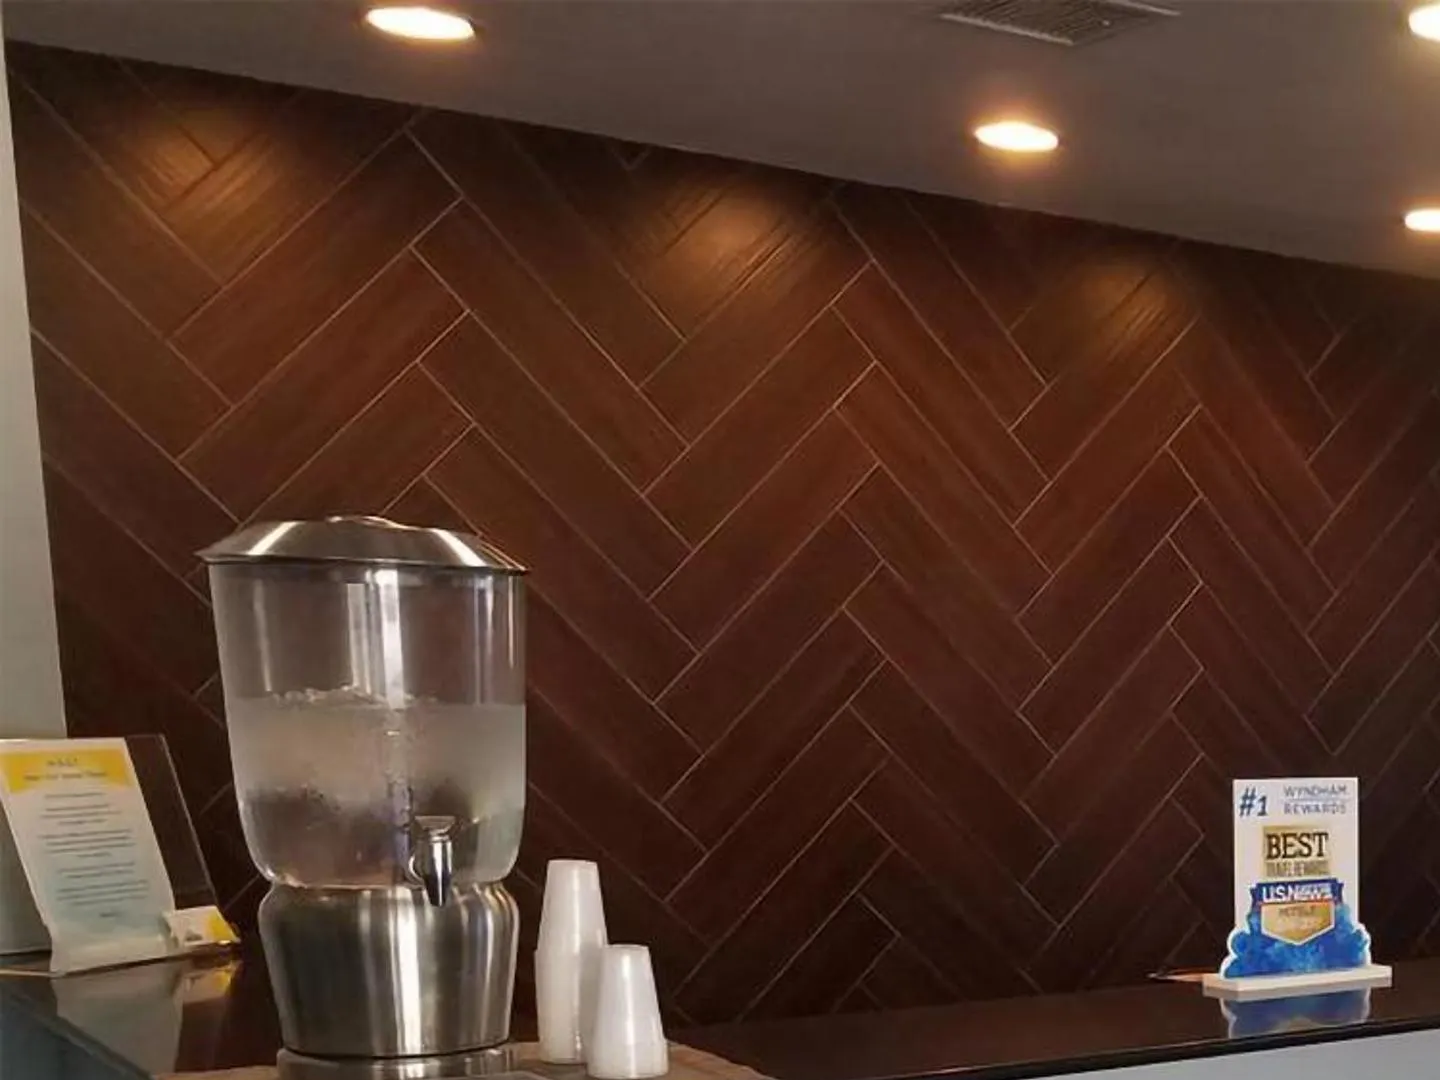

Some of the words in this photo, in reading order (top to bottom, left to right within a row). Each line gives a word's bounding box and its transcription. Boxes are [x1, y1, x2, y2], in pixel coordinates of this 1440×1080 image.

[1283, 784, 1347, 797] WYNDHAM
[1239, 786, 1268, 818] #1
[1284, 802, 1346, 815] REWARDS
[1266, 832, 1328, 859] BEST
